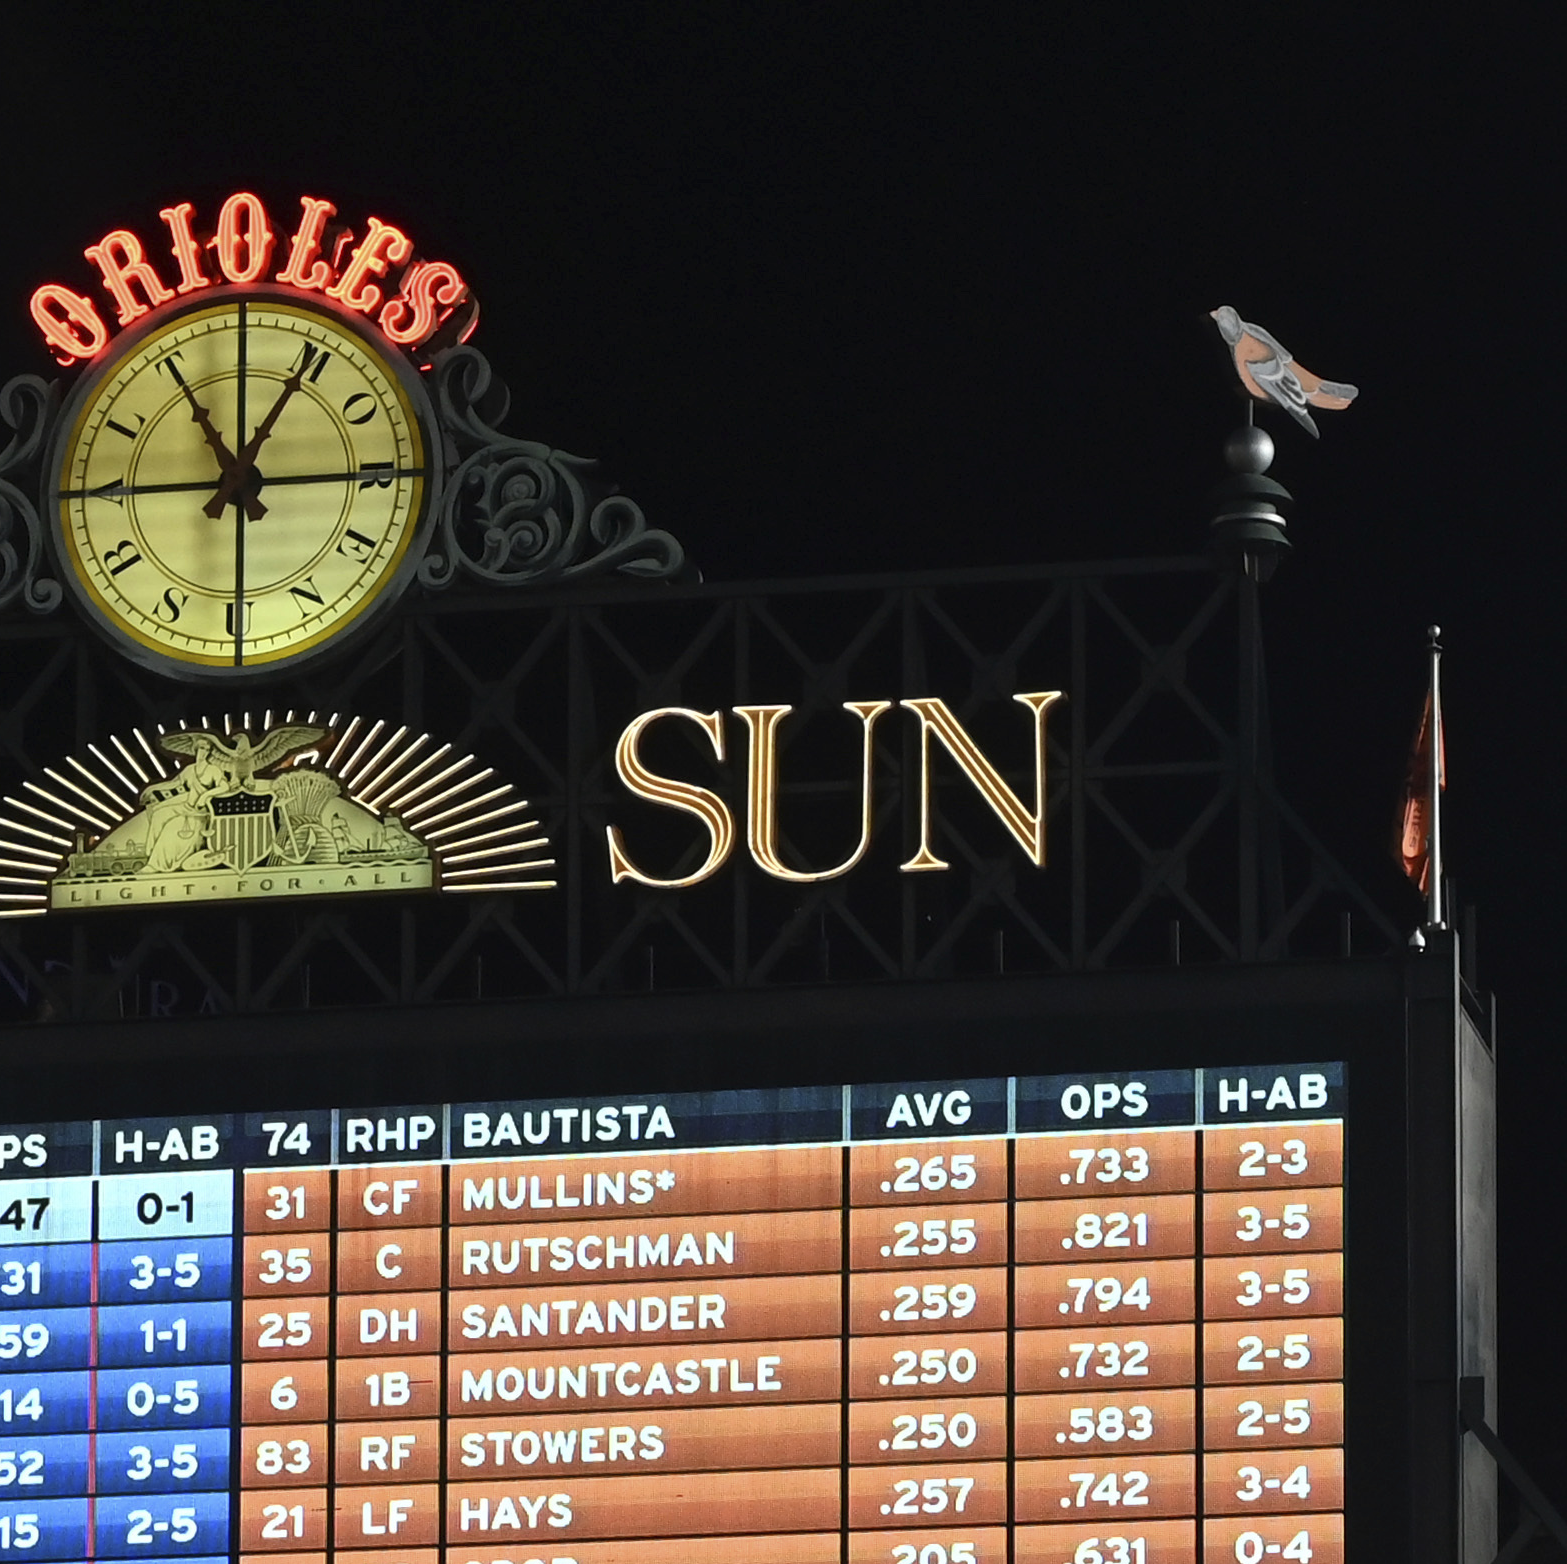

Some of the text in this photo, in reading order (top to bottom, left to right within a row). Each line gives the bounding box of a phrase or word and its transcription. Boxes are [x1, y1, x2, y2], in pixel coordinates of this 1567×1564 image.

[29, 191, 470, 365] ORIOLES
[88, 330, 395, 580] BALTMORE
[606, 690, 1068, 889] SUN
[69, 869, 414, 903] LIGHT FOR ALL
[262, 1073, 1328, 1156] 74 RHP BAUTISTA AVG OPS H-AB
[115, 1125, 219, 1164] H-AB
[136, 1191, 194, 1225] 0-1
[462, 1230, 734, 1276] RUTSCHMAN
[462, 1293, 726, 1339] SANTANDER
[461, 1355, 782, 1403] MOUNTCASTLE
[461, 1425, 665, 1467] STOWERS
[460, 1493, 573, 1531] HAYS
